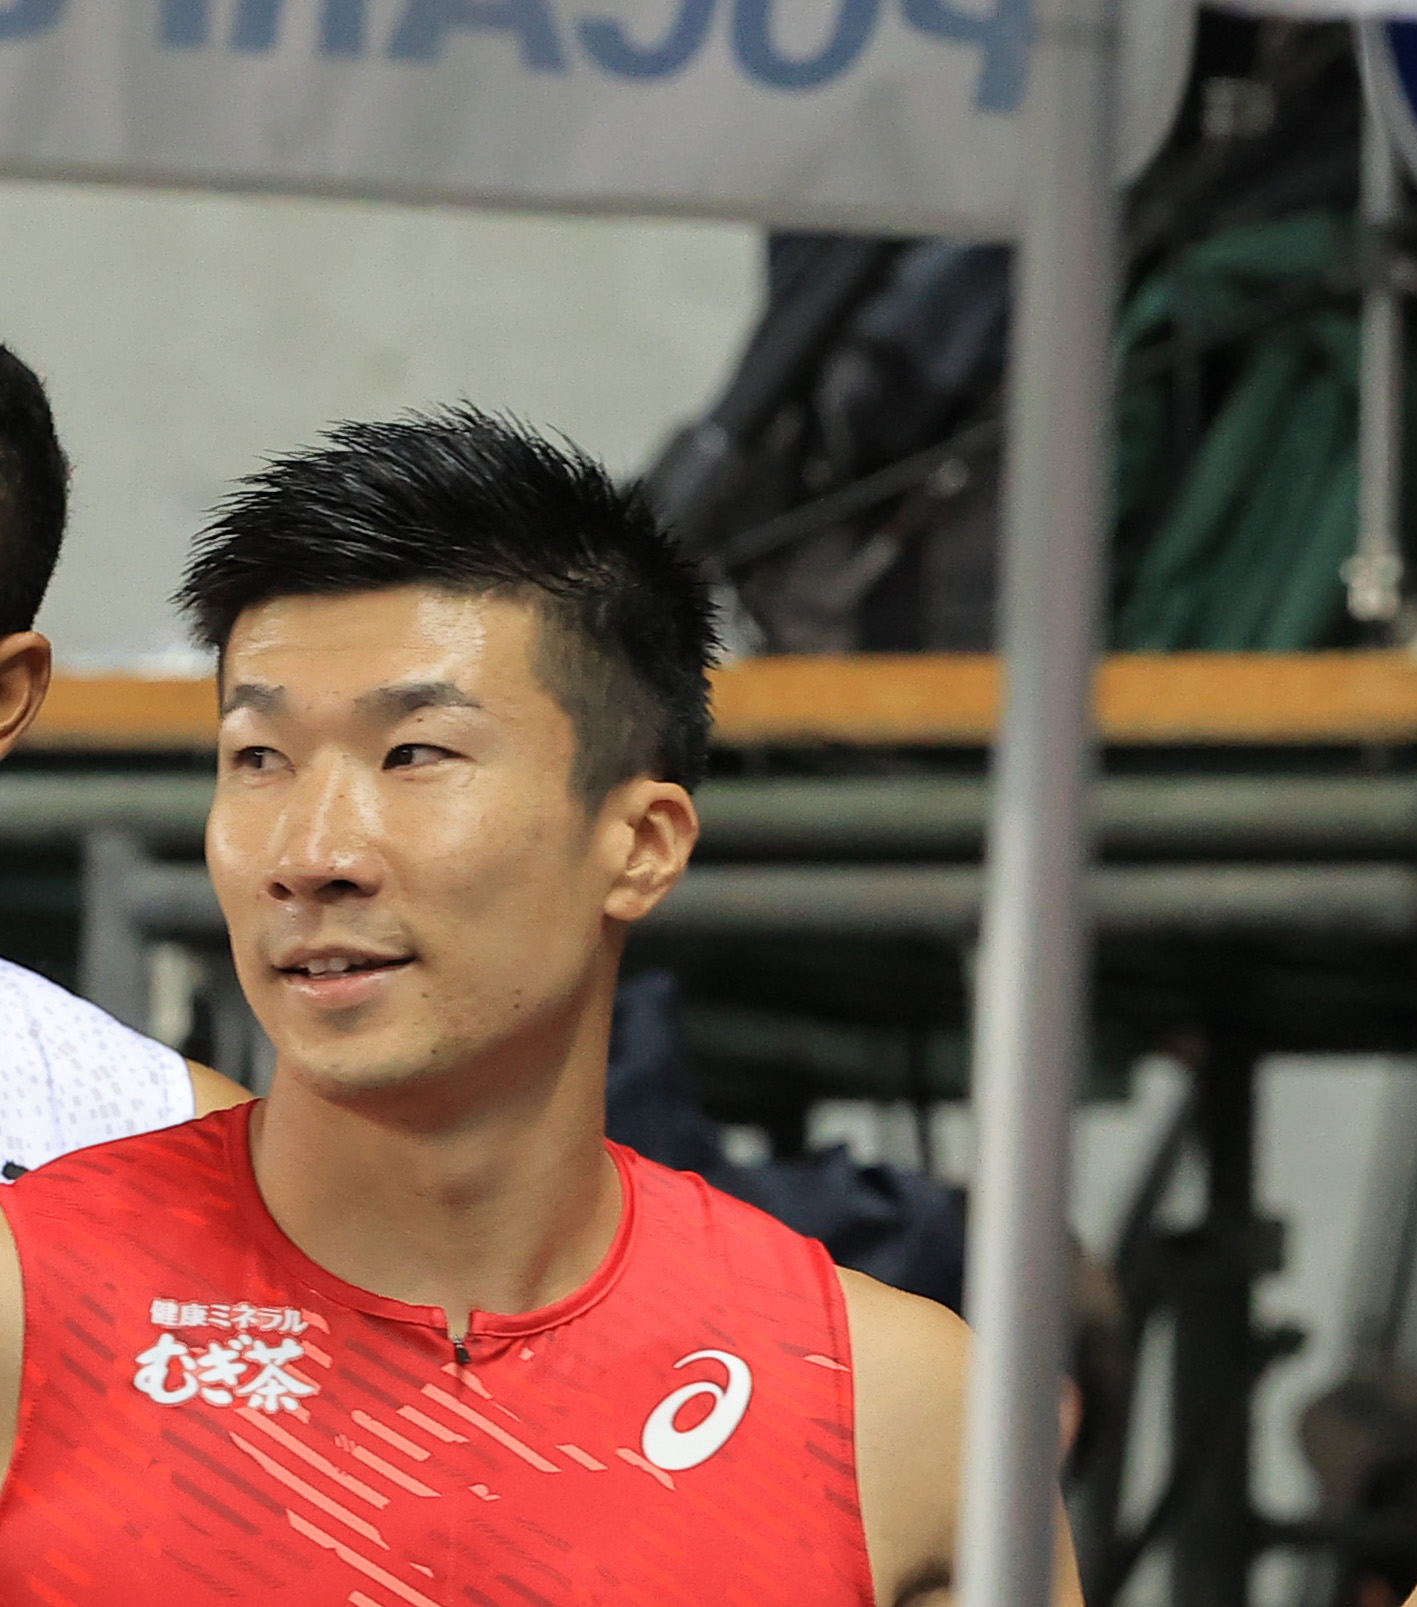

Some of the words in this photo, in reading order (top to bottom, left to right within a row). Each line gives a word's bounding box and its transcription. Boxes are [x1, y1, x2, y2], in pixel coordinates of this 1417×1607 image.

[149, 1298, 310, 1334] 健康ミネラル
[133, 1332, 317, 1413] むぎ茶
